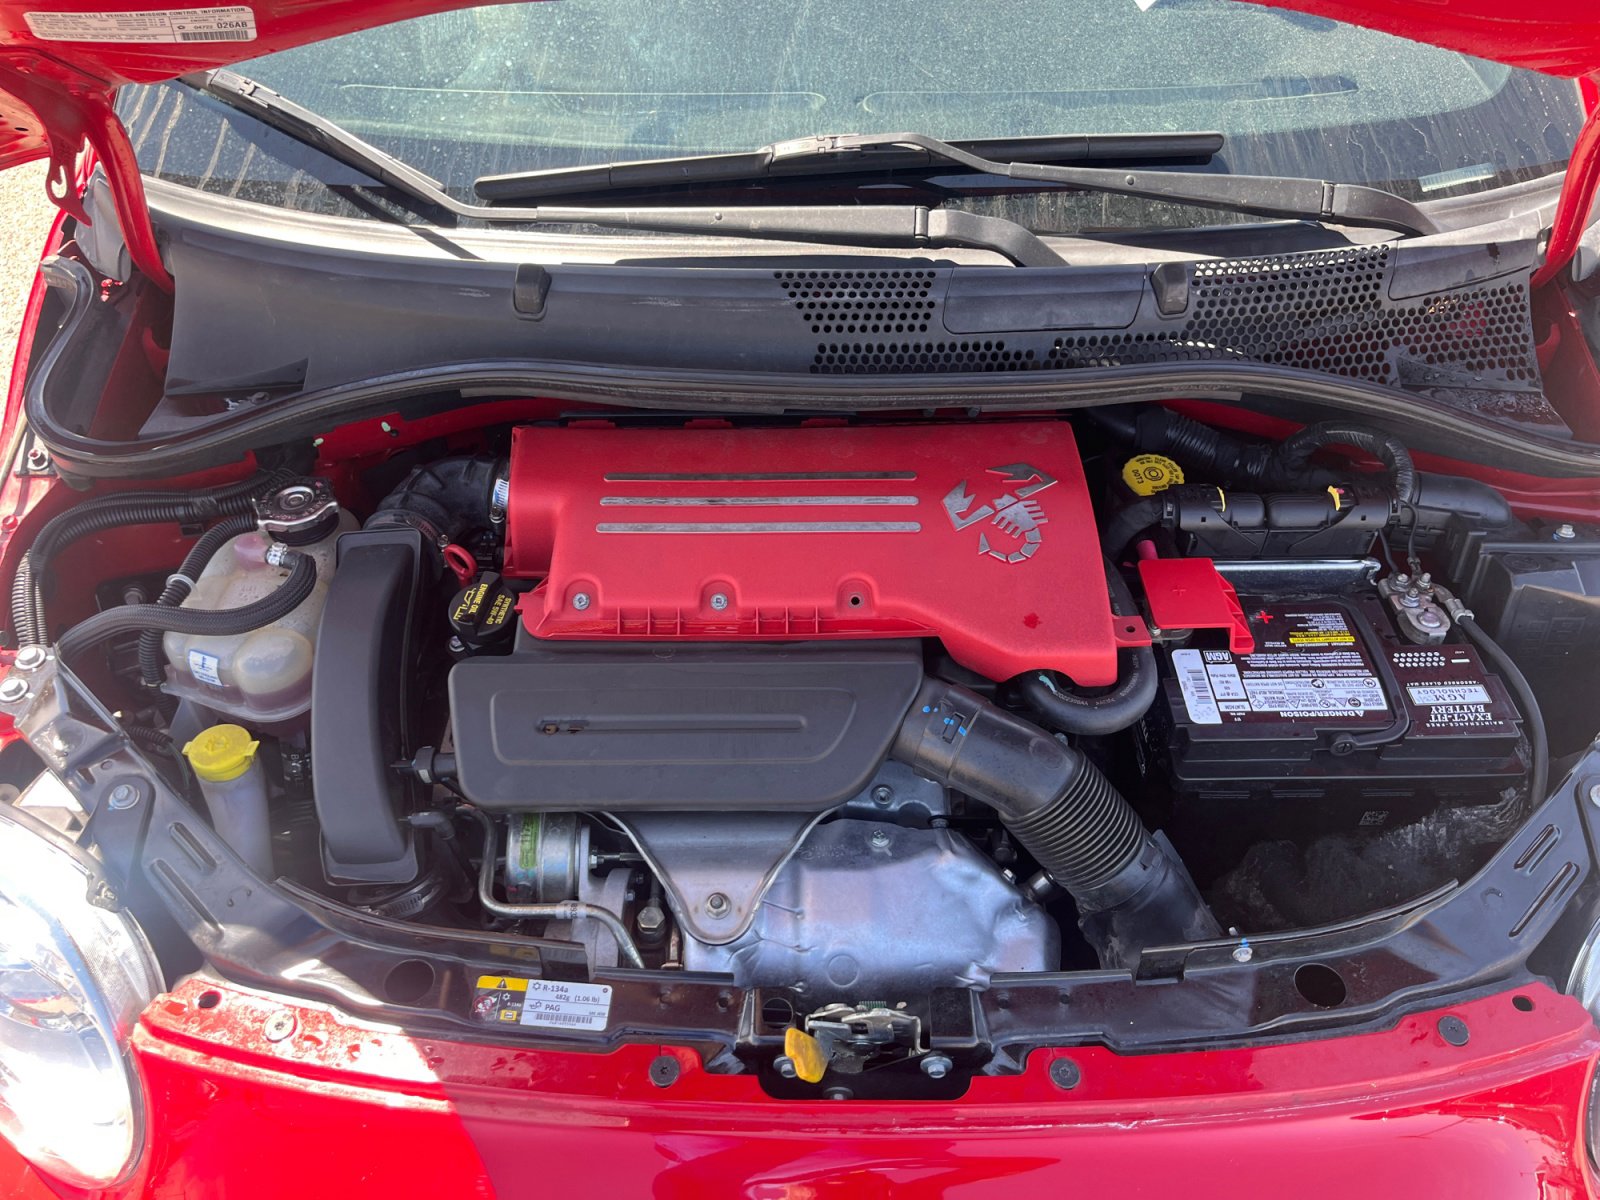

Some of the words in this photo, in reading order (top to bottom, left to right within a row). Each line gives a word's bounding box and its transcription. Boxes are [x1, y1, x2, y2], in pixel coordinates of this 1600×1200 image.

[135, 11, 168, 19] EMISSION
[169, 9, 199, 17] CONTROL
[201, 7, 246, 16] INFORMATION
[216, 21, 248, 29] 026AB
[474, 584, 488, 604] ENGINE
[495, 594, 505, 606] SAE
[468, 605, 478, 614] OIL
[1206, 652, 1230, 661] AGM
[1433, 693, 1466, 702] AGM
[1431, 705, 1485, 714] BATTERY
[1429, 712, 1492, 722] EXACT-FIT
[543, 984, 569, 993] R-134a
[574, 994, 591, 1003] (1.06
[592, 996, 600, 1004] lb)
[545, 1004, 561, 1012] PAG
